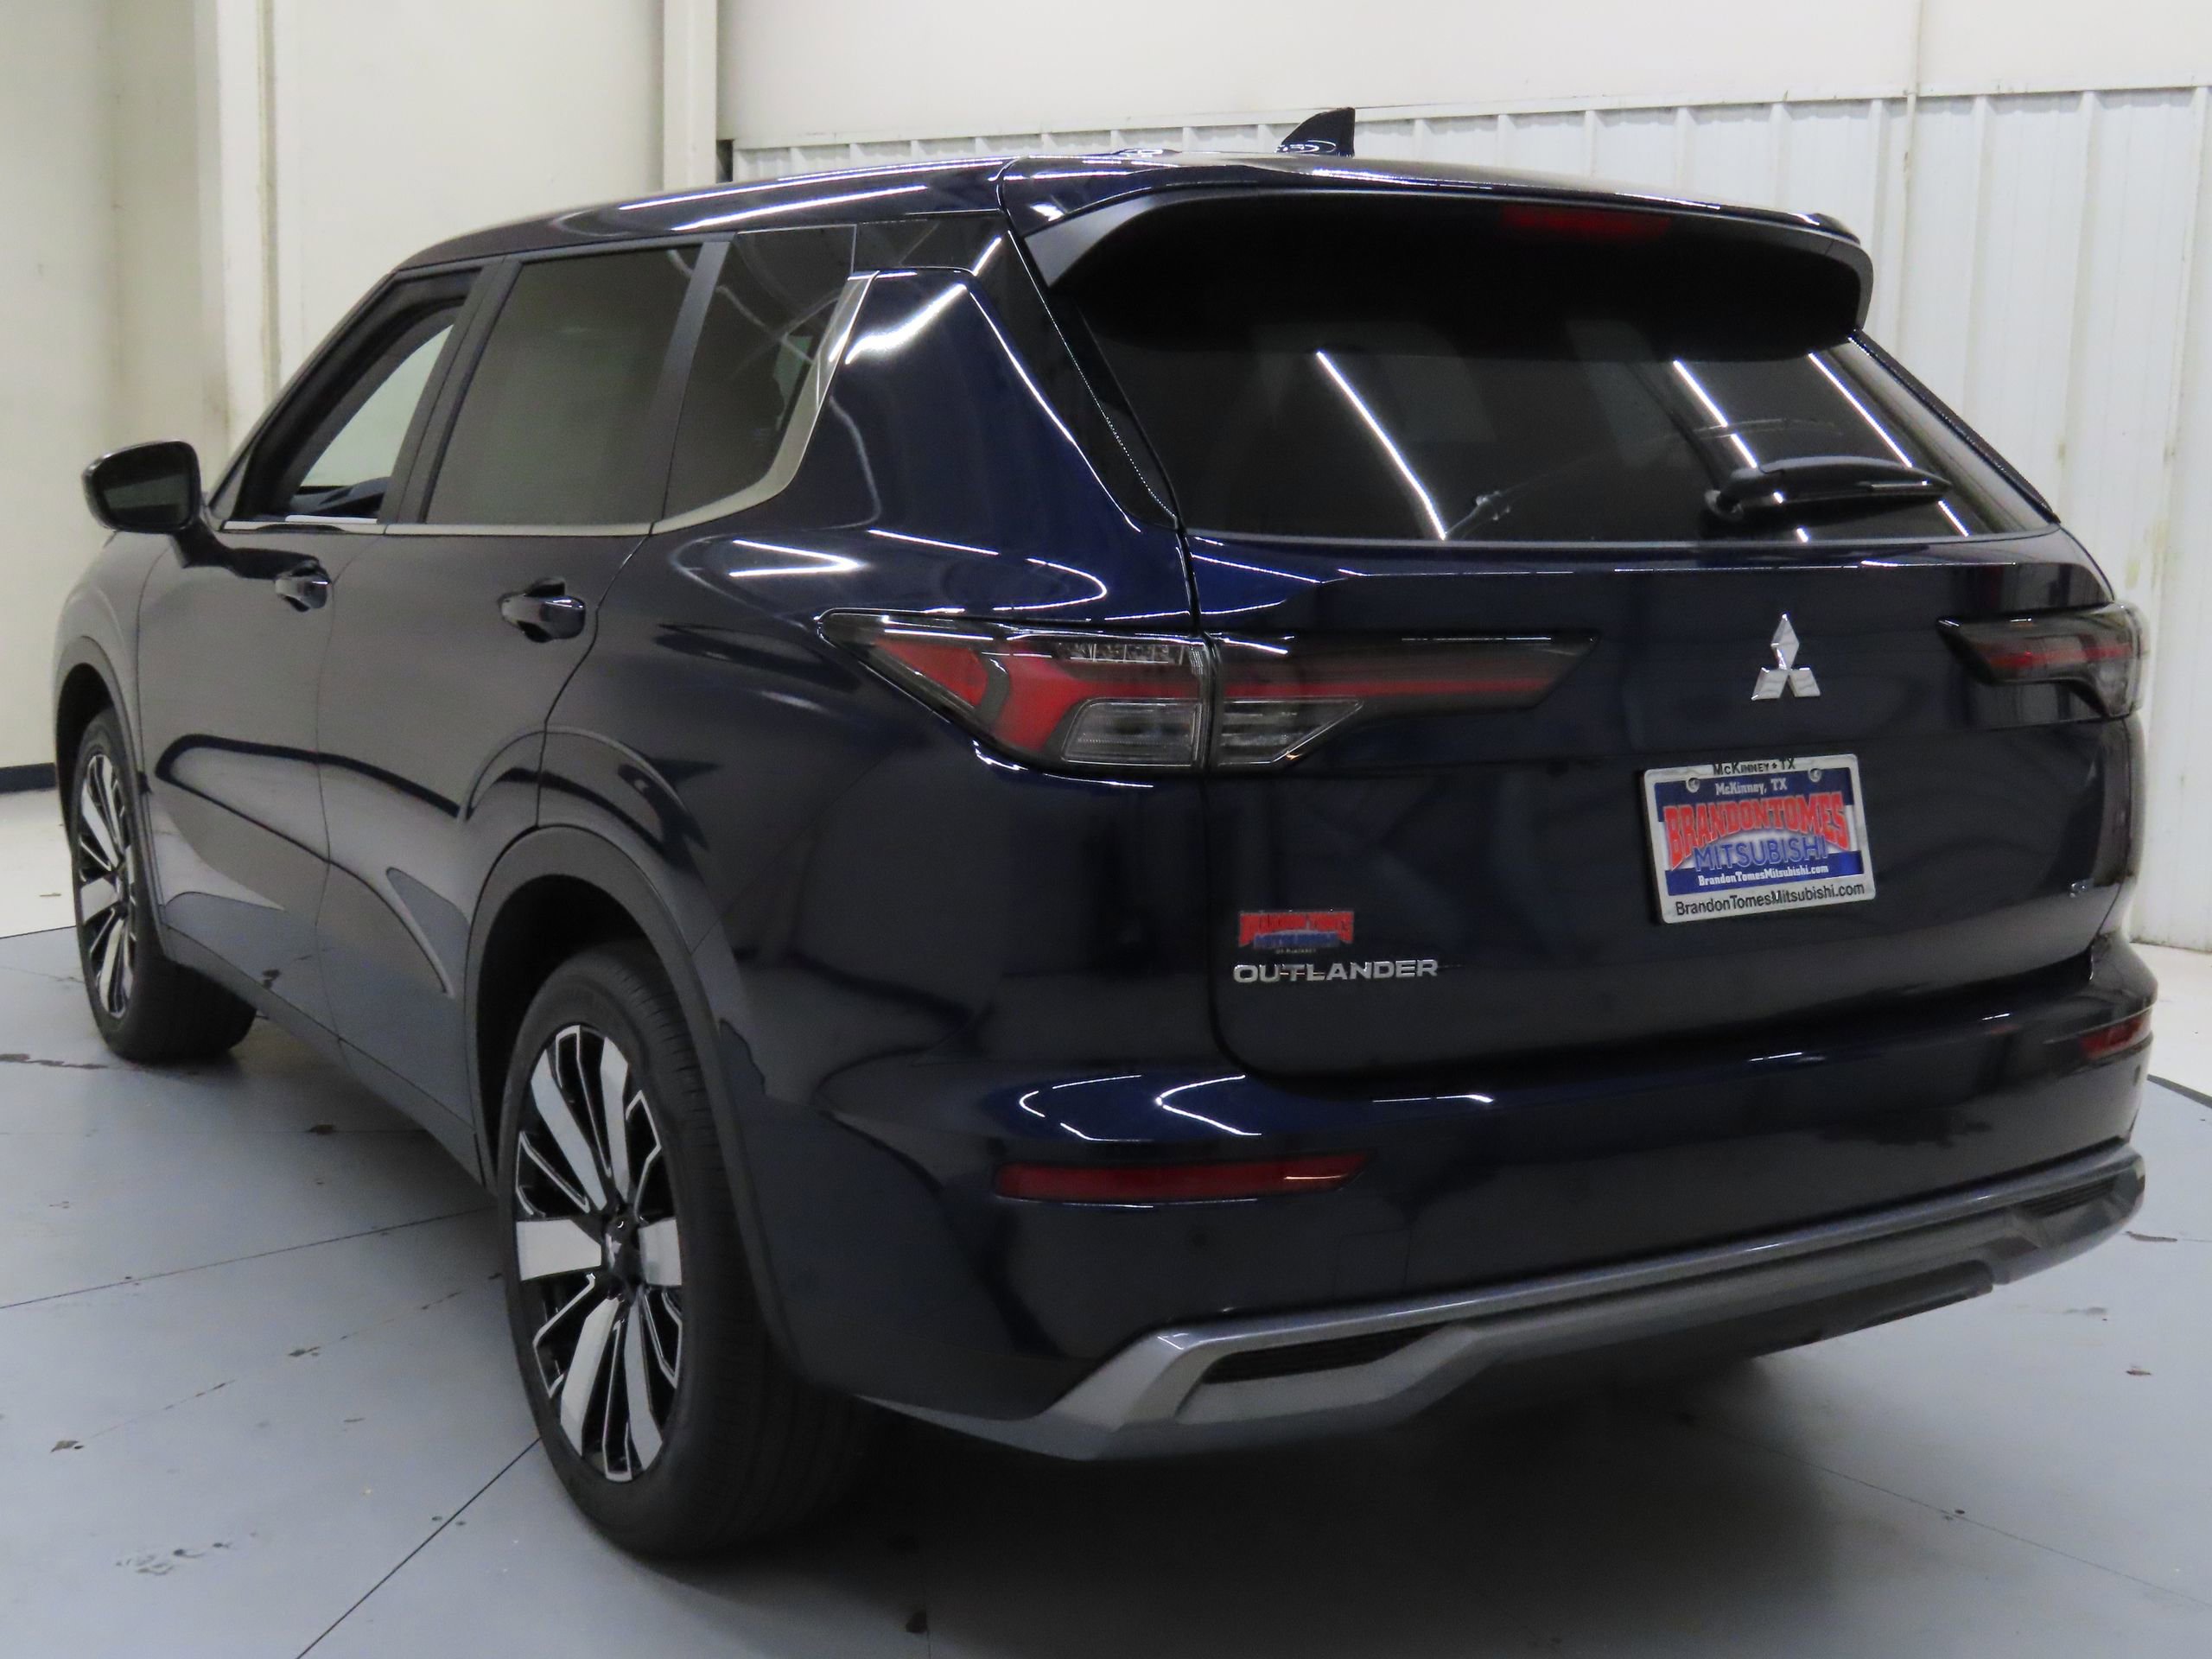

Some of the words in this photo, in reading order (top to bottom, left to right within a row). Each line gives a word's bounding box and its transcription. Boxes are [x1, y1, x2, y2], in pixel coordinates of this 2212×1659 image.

[1779, 757, 1796, 771] TX
[1715, 781, 1767, 796] McKinney,
[1770, 778, 1788, 791] TX
[1693, 835, 1829, 872] MITSUBISHI
[1698, 865, 1829, 887] BrandonTomesMitsubishi.com
[1675, 883, 1865, 917] BrandonTomesMitsubishi.com
[1233, 959, 1439, 983] OUTLANDER
